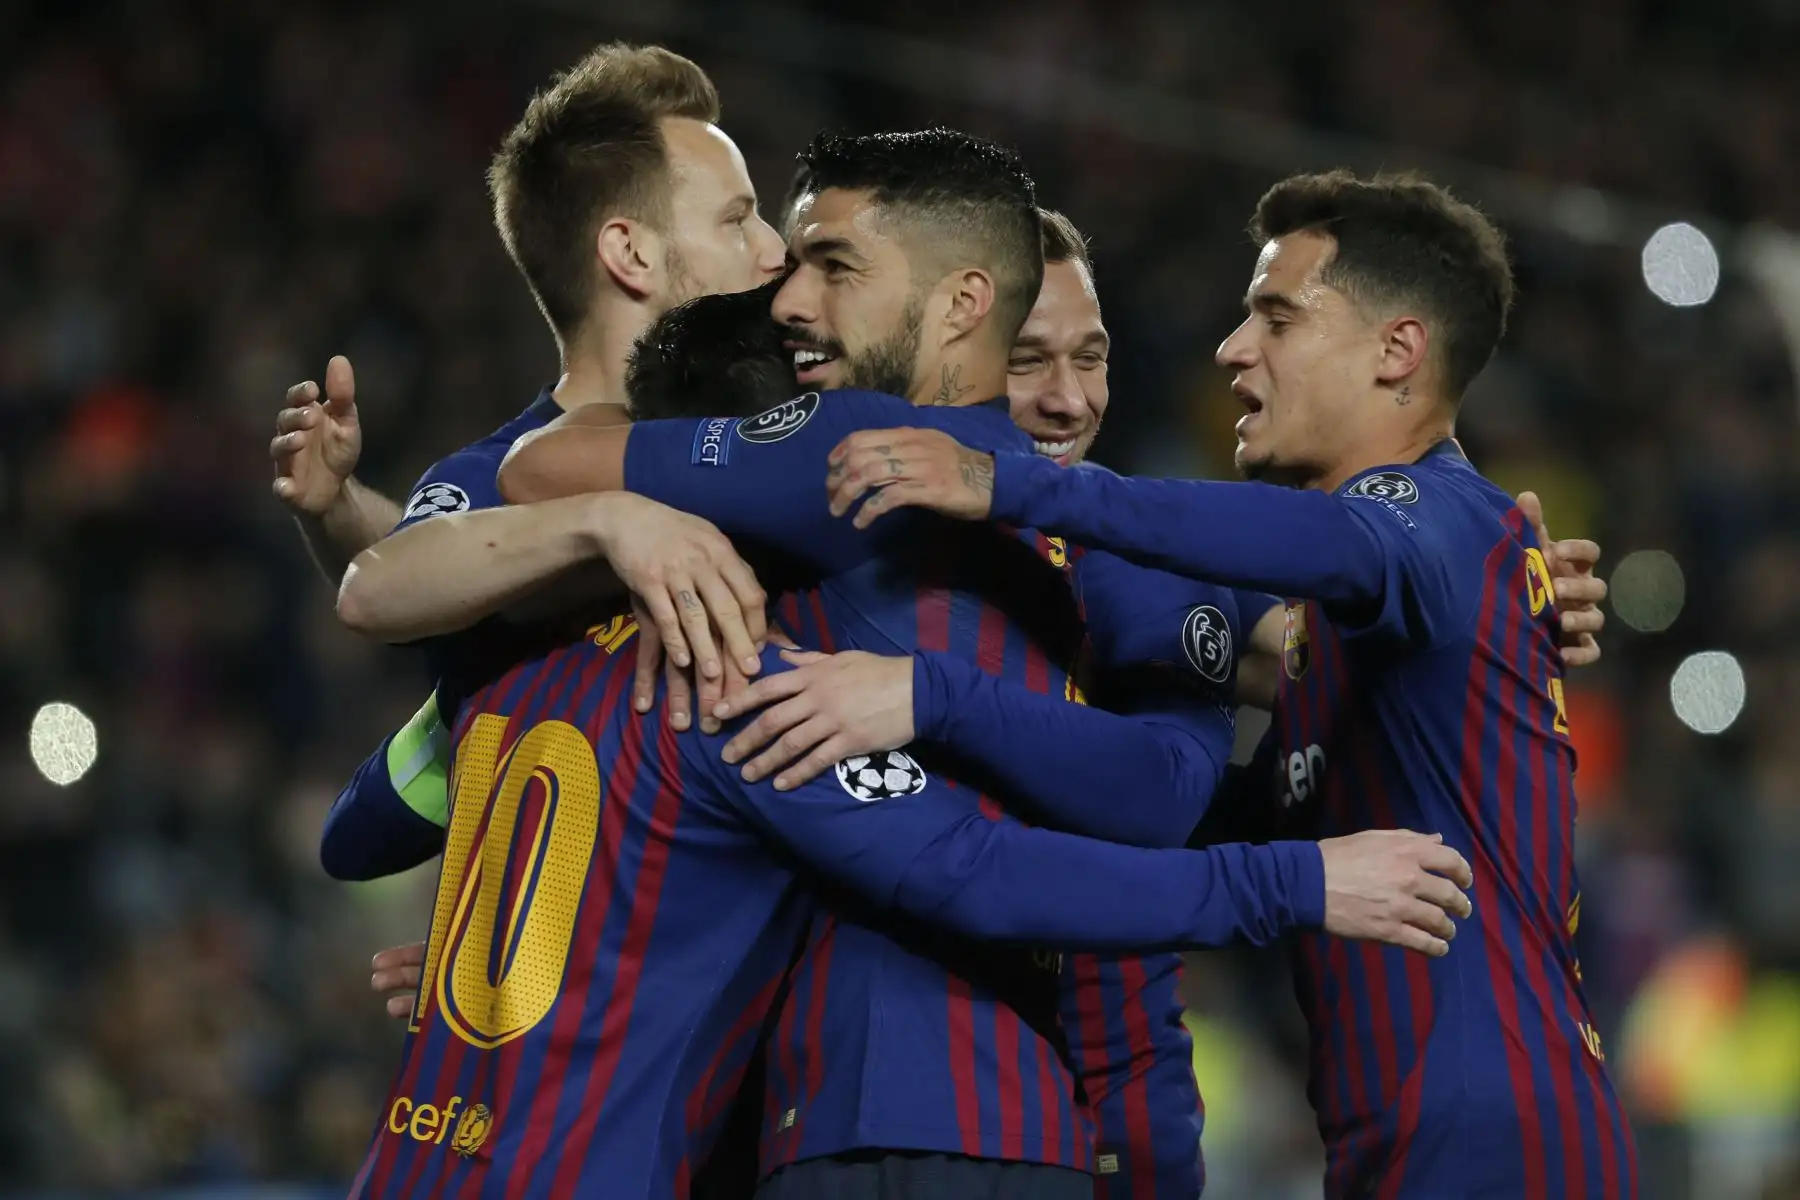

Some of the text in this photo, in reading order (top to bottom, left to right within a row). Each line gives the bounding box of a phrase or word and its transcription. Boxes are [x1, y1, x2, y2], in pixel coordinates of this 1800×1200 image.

[758, 411, 780, 426] 5
[1371, 484, 1393, 496] 5
[1204, 640, 1219, 662] 5
[409, 713, 600, 1050] 10
[388, 1095, 463, 1145] cef
